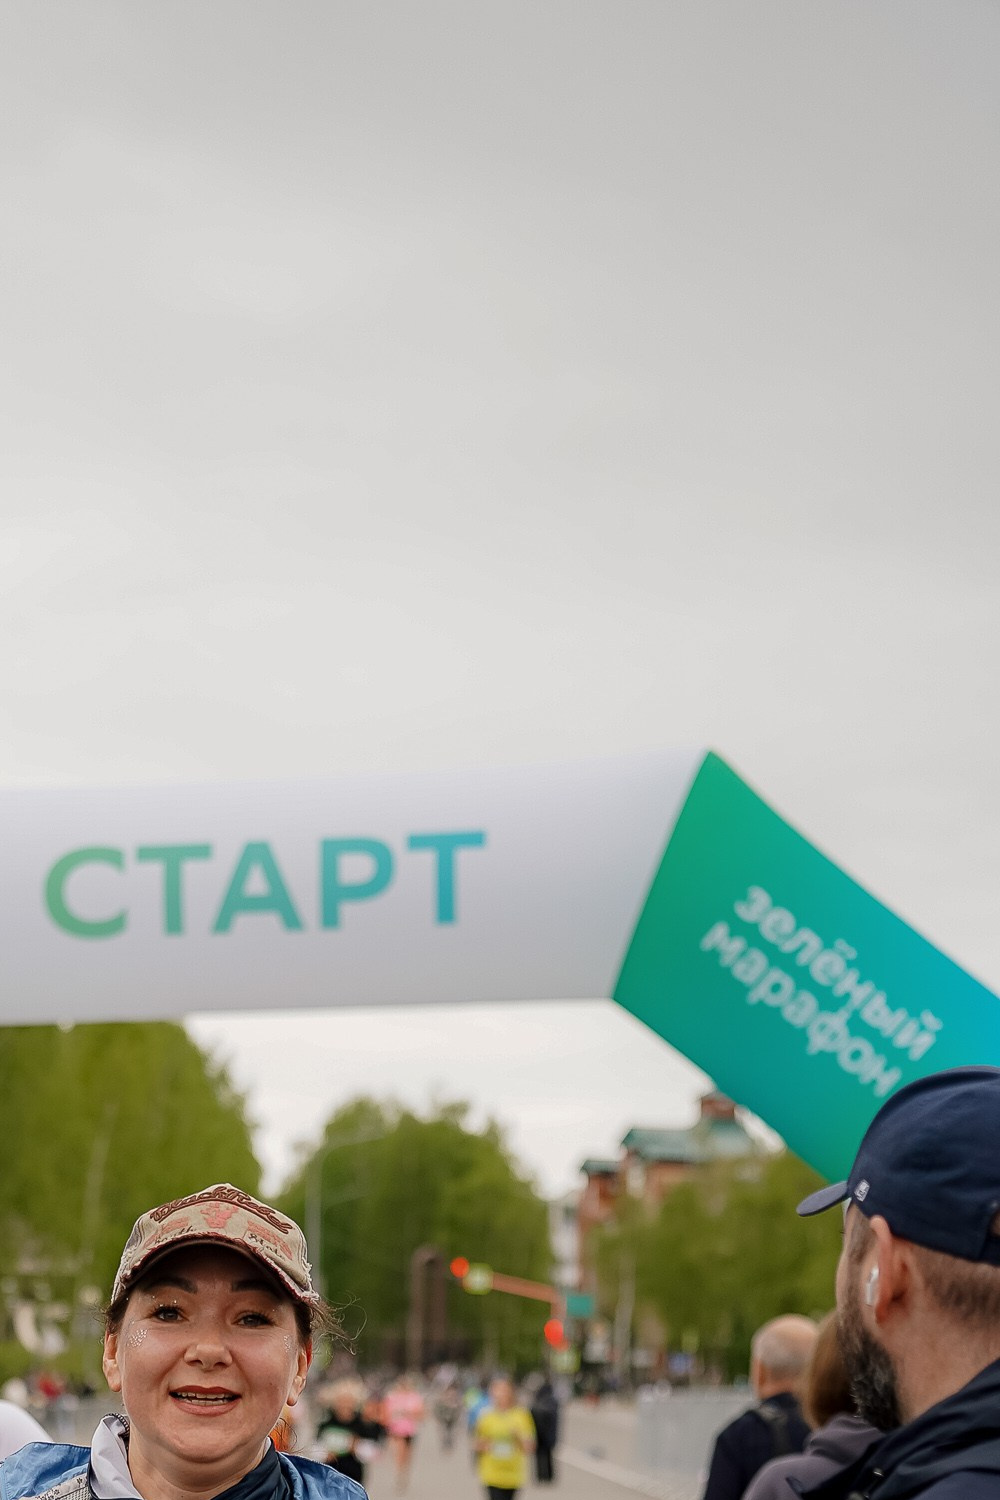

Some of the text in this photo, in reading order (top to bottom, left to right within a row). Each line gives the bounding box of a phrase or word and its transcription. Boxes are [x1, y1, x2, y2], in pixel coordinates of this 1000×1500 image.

[45, 830, 487, 940] СТАРТ
[734, 885, 944, 1061] зелёный
[699, 920, 902, 1098] марафон
